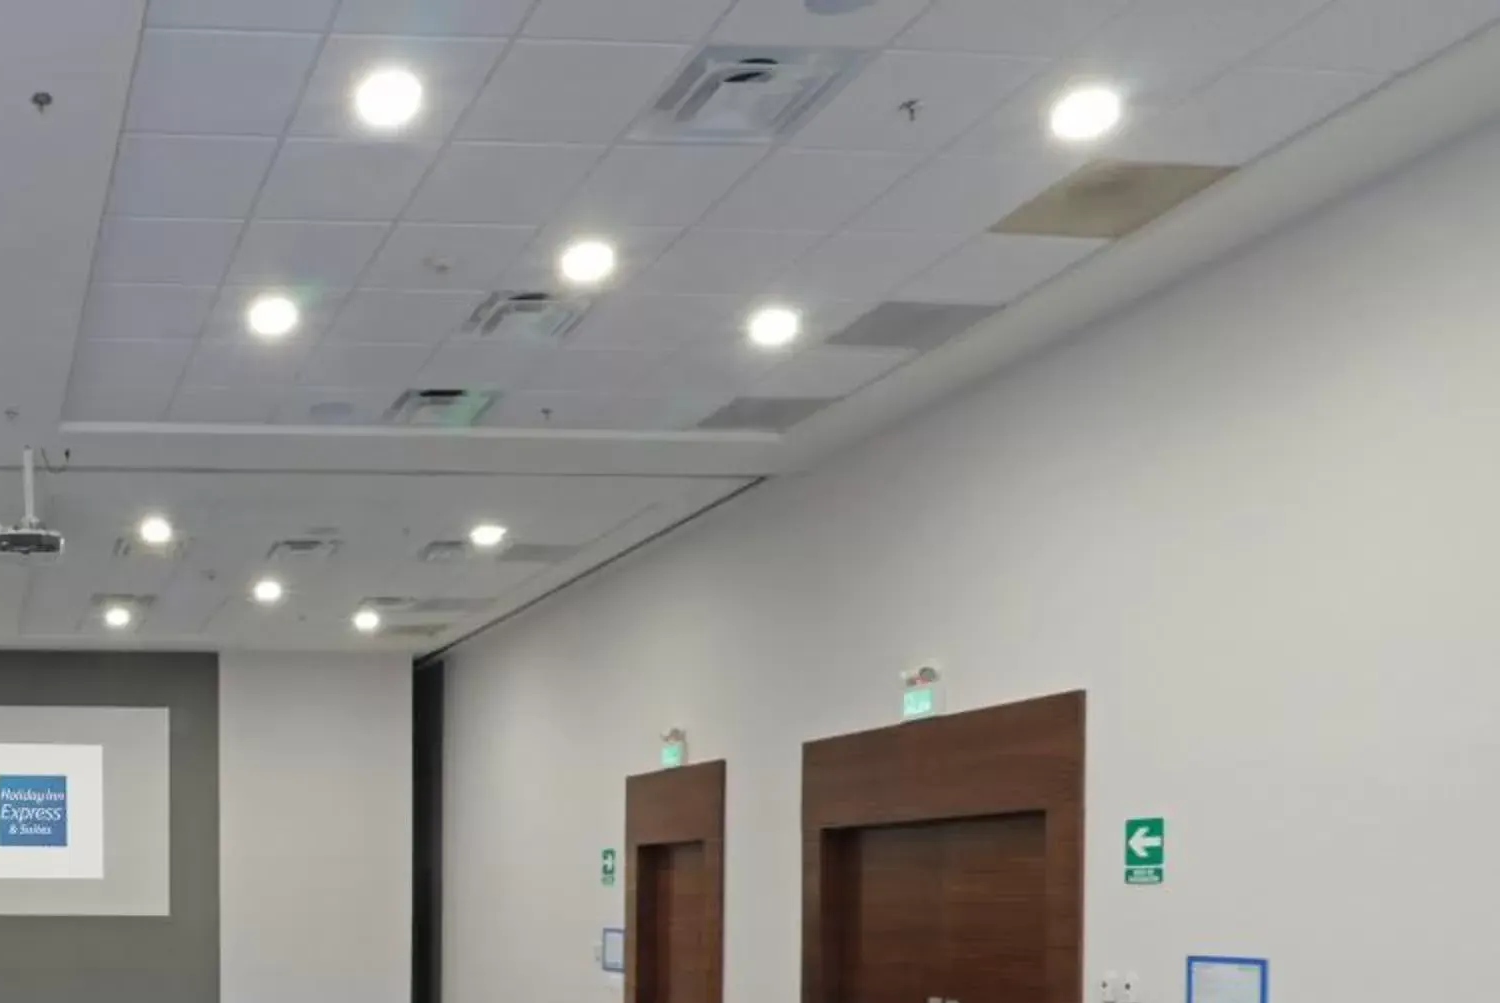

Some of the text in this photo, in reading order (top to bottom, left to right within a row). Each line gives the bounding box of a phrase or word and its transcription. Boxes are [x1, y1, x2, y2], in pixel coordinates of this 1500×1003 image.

[1, 787, 65, 804] Holiday Inn
[1, 803, 62, 822] Express
[19, 824, 52, 835] Suites
